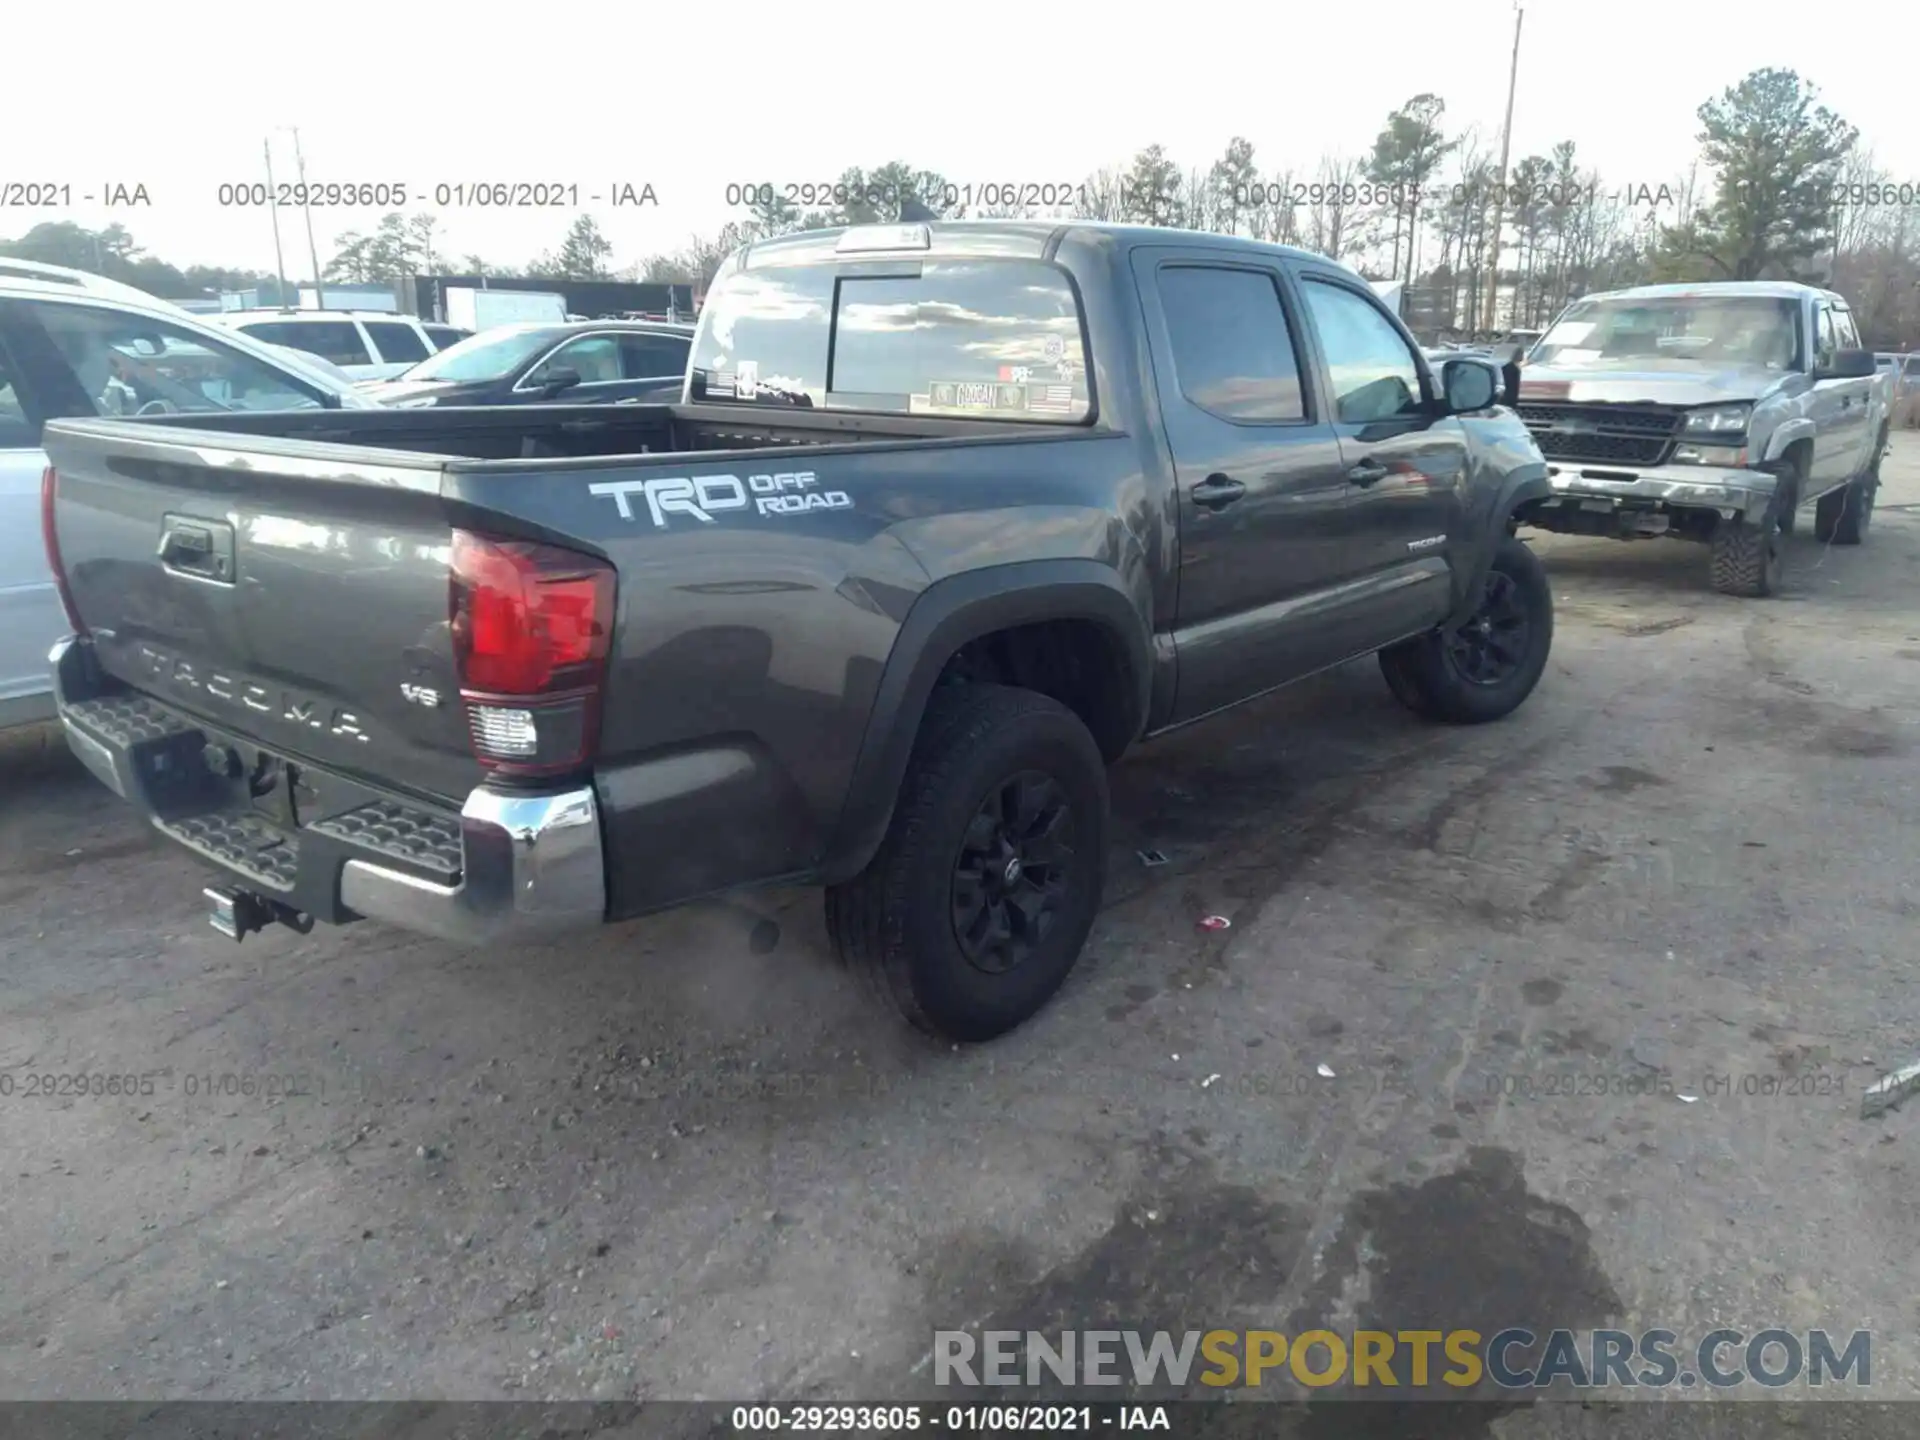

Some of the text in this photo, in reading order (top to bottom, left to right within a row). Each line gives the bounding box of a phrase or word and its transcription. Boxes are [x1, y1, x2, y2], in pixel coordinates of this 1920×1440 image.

[748, 471, 816, 492] OFF
[588, 474, 747, 526] TRD
[755, 491, 851, 515] ROAD
